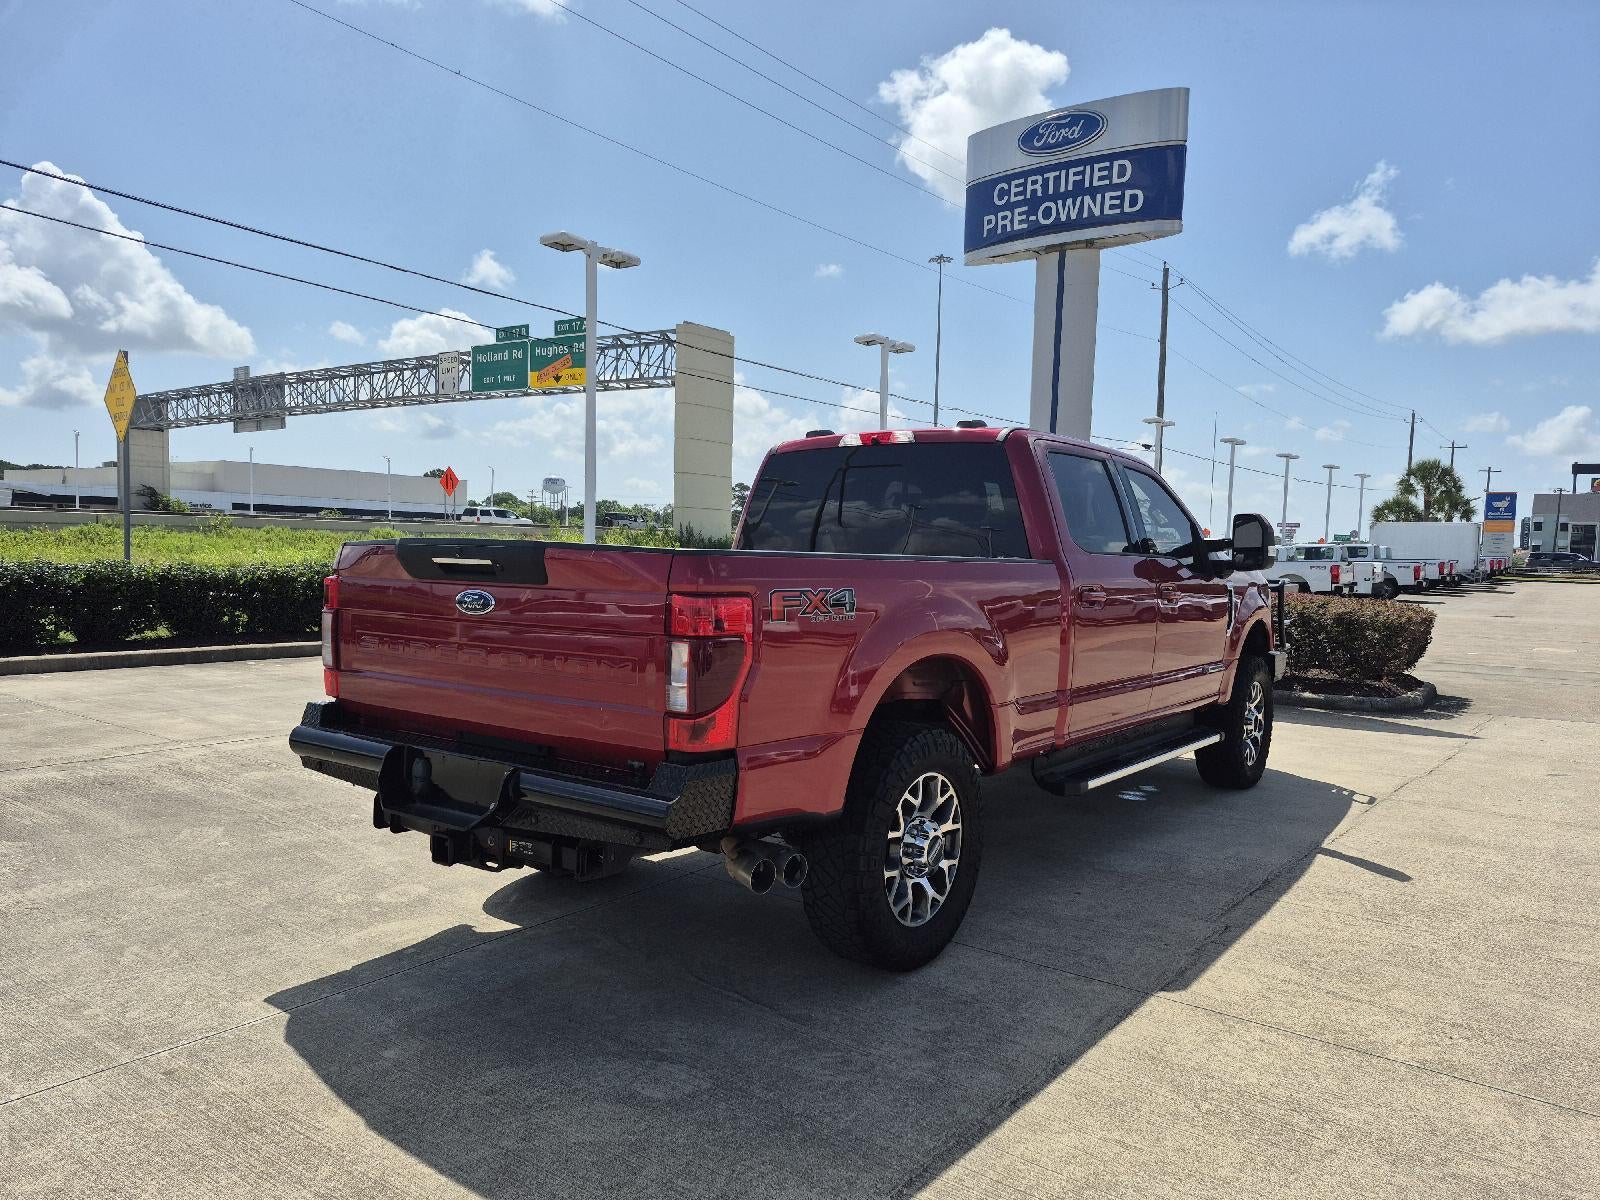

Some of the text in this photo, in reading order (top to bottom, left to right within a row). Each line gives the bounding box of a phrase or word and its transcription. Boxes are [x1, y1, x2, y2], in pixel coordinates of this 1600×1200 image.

[1032, 116, 1084, 148] Ford
[993, 159, 1133, 207] CERTIFIED
[983, 189, 1144, 238] PRE-OWNED
[557, 323, 570, 332] EXIT
[572, 320, 580, 331] 17
[476, 349, 523, 363] Holland Rd
[535, 342, 585, 358] Hughes Rd
[440, 356, 458, 365] SPEED
[441, 367, 455, 375] LIMIT
[565, 372, 583, 381] ONLY
[498, 375, 502, 384] 1
[462, 594, 484, 608] Ford
[769, 588, 856, 623] FX4
